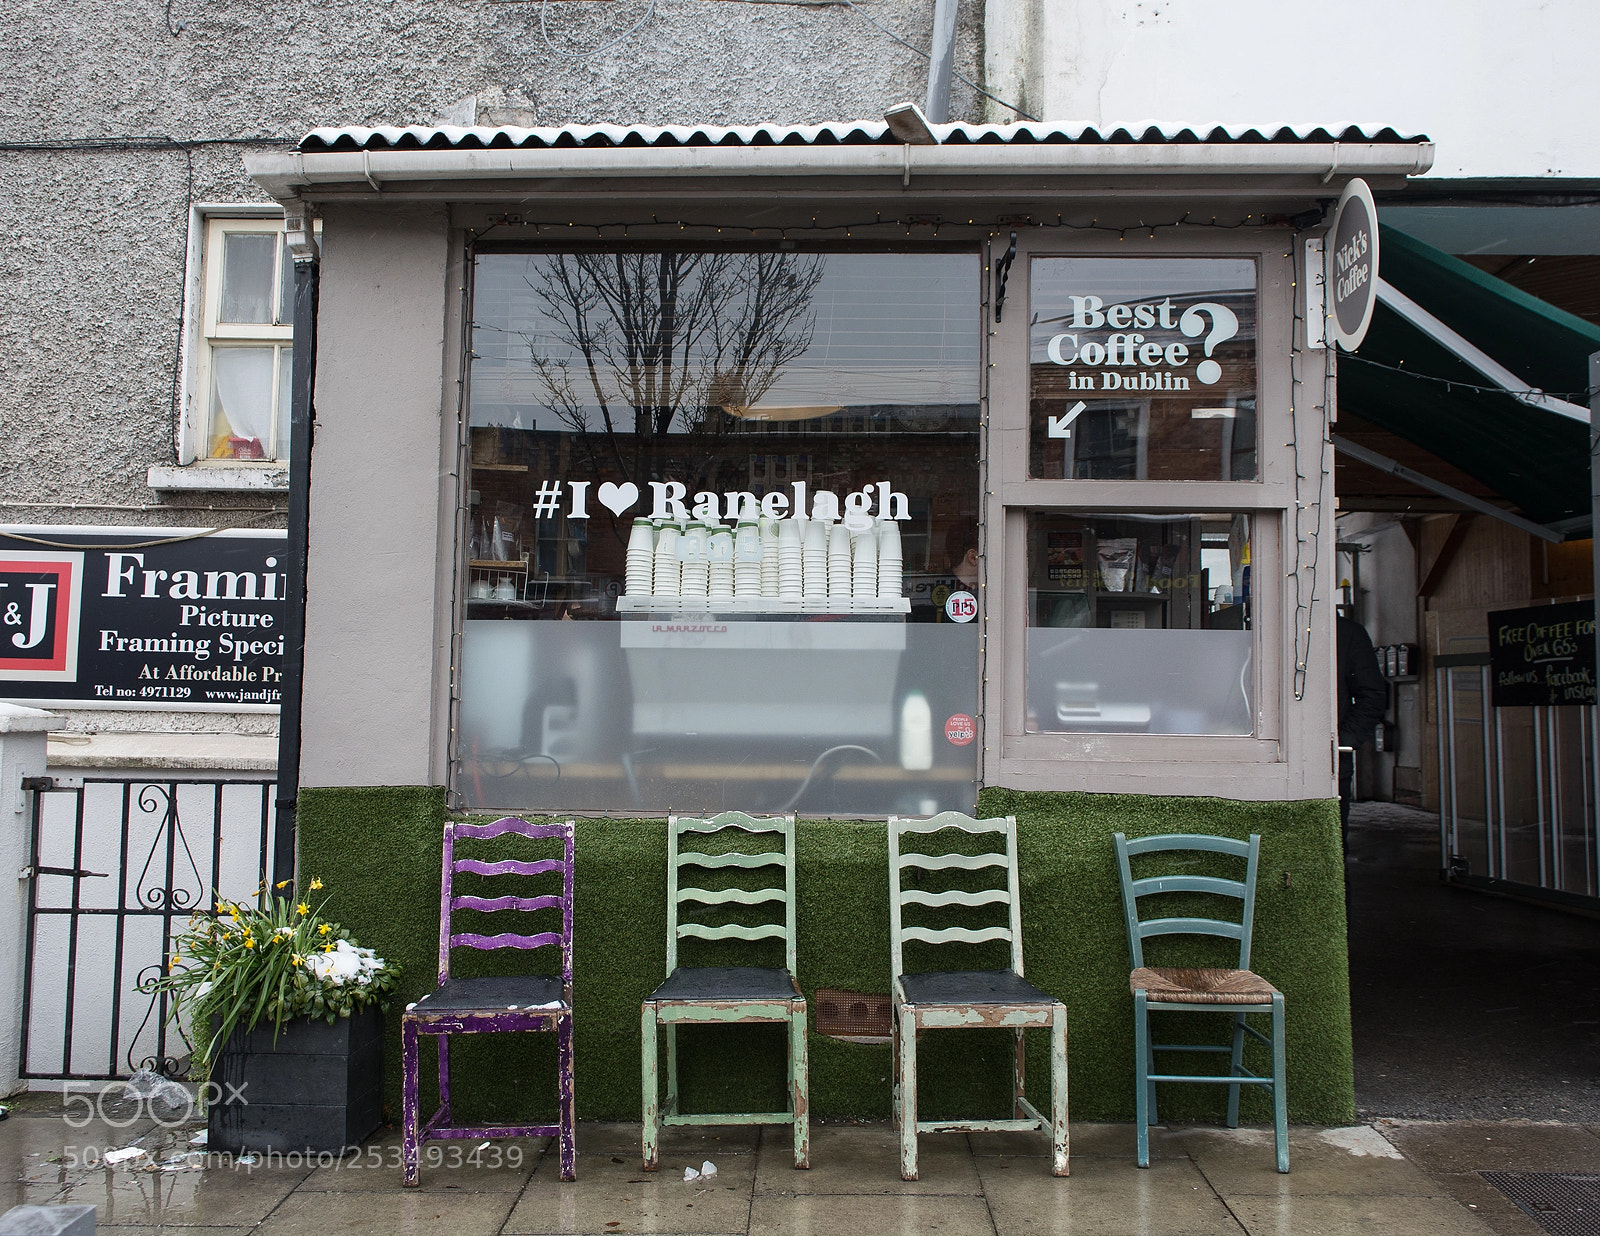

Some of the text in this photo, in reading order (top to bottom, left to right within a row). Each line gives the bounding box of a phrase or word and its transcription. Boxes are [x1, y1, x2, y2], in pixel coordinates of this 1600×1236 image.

[1336, 229, 1367, 277] Nick's
[1337, 262, 1369, 303] Coffee
[1068, 295, 1177, 329] Best
[1047, 333, 1189, 366] Coffee
[1069, 371, 1190, 391] in Dublin
[648, 480, 911, 531] Ranelagh
[179, 604, 274, 628] Picture
[98, 630, 284, 661] Framing Speci
[1499, 625, 1526, 646] FREE
[1552, 637, 1578, 656] 65s
[138, 663, 282, 683] At Affordable Pr
[95, 684, 113, 697] Tel
[116, 687, 136, 698] no:
[139, 685, 192, 699] 4971129
[948, 730, 965, 739] yelp
